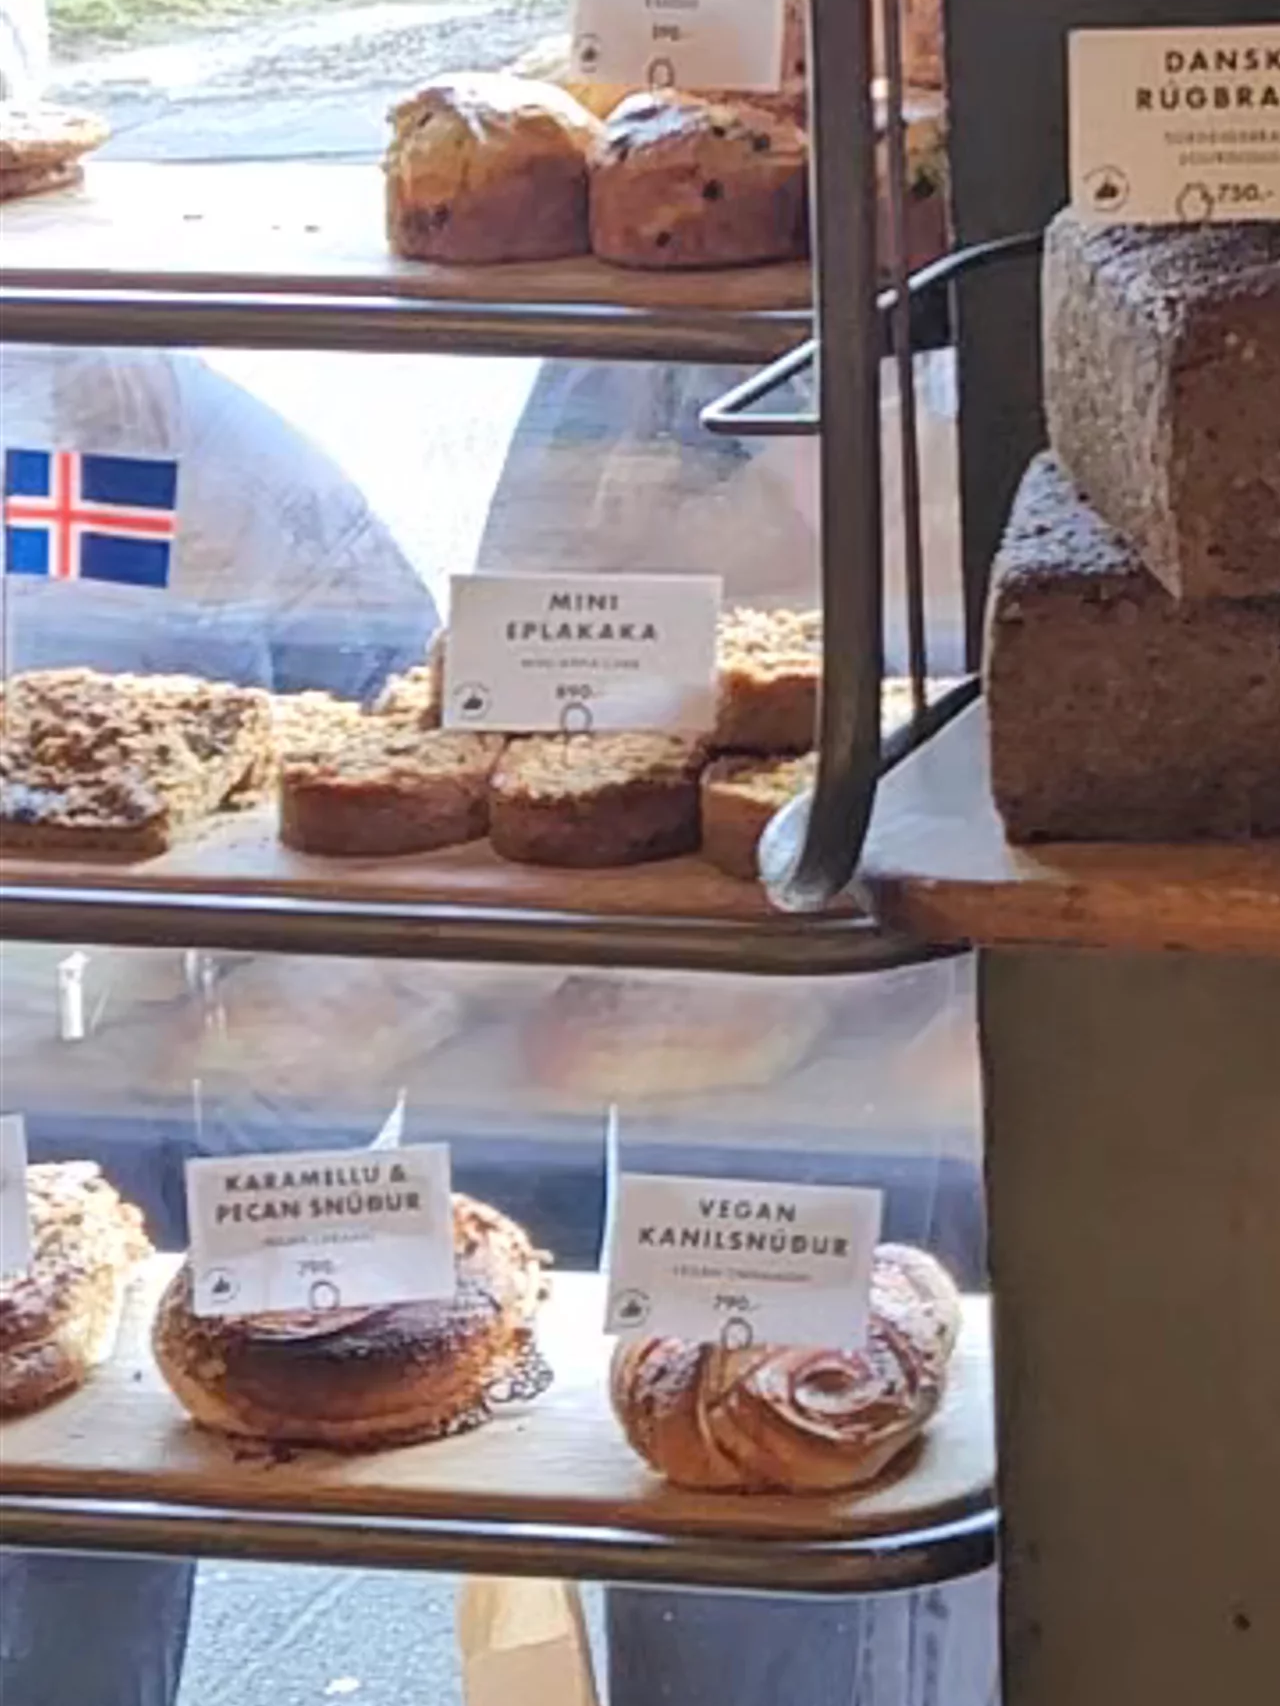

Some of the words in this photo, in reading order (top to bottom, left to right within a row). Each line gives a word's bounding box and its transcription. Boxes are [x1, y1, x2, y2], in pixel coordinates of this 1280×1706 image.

[549, 594, 619, 611] MINI
[506, 622, 658, 641] EPLAKAKA
[224, 1165, 380, 1193] KARAMELLU
[389, 1163, 408, 1183] &
[216, 1199, 300, 1224] PECAN
[699, 1199, 797, 1222] VEGAN
